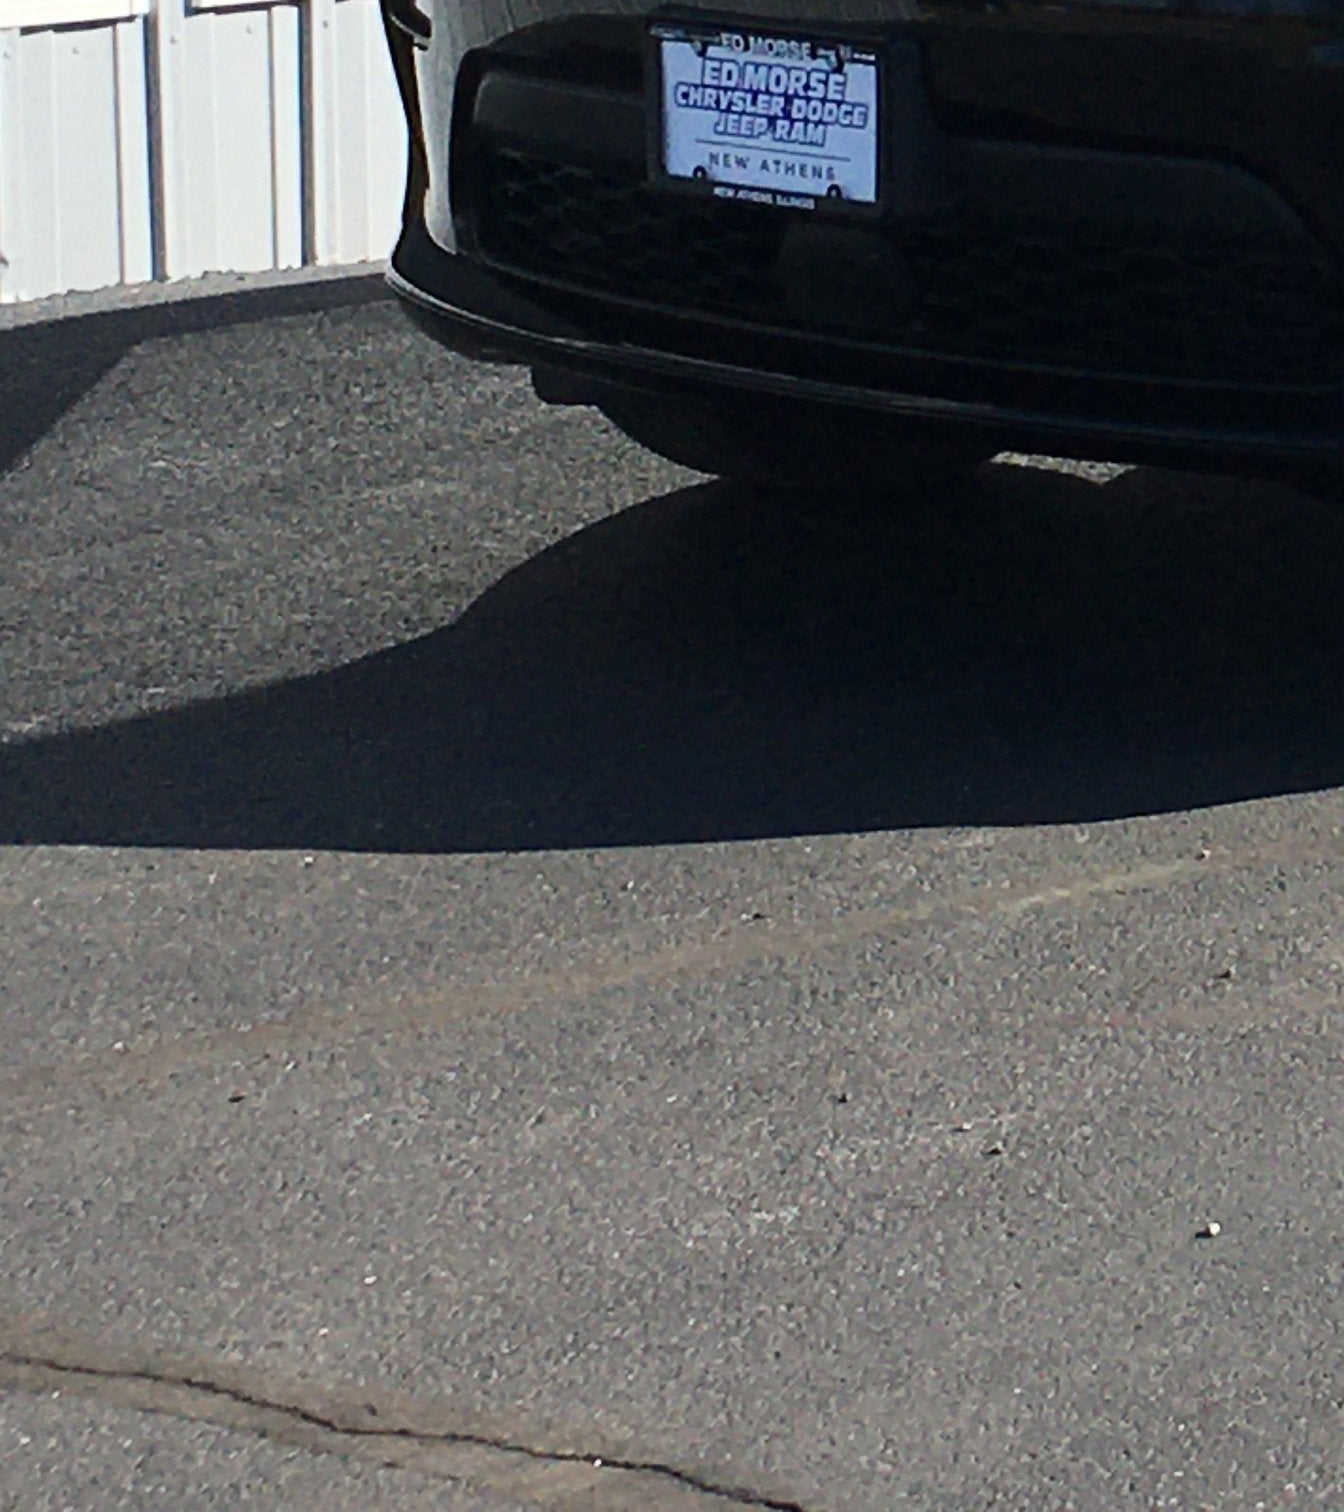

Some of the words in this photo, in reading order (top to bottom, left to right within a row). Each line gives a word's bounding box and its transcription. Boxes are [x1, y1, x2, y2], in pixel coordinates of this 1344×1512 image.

[702, 59, 739, 87] ED
[744, 63, 846, 100] MORSE
[675, 86, 785, 117] CHRYSLER
[791, 98, 867, 126] DODGE
[716, 113, 768, 137] JEEP
[775, 119, 826, 146] RAM
[708, 151, 750, 169] NEW
[760, 158, 836, 180] ATHENS
